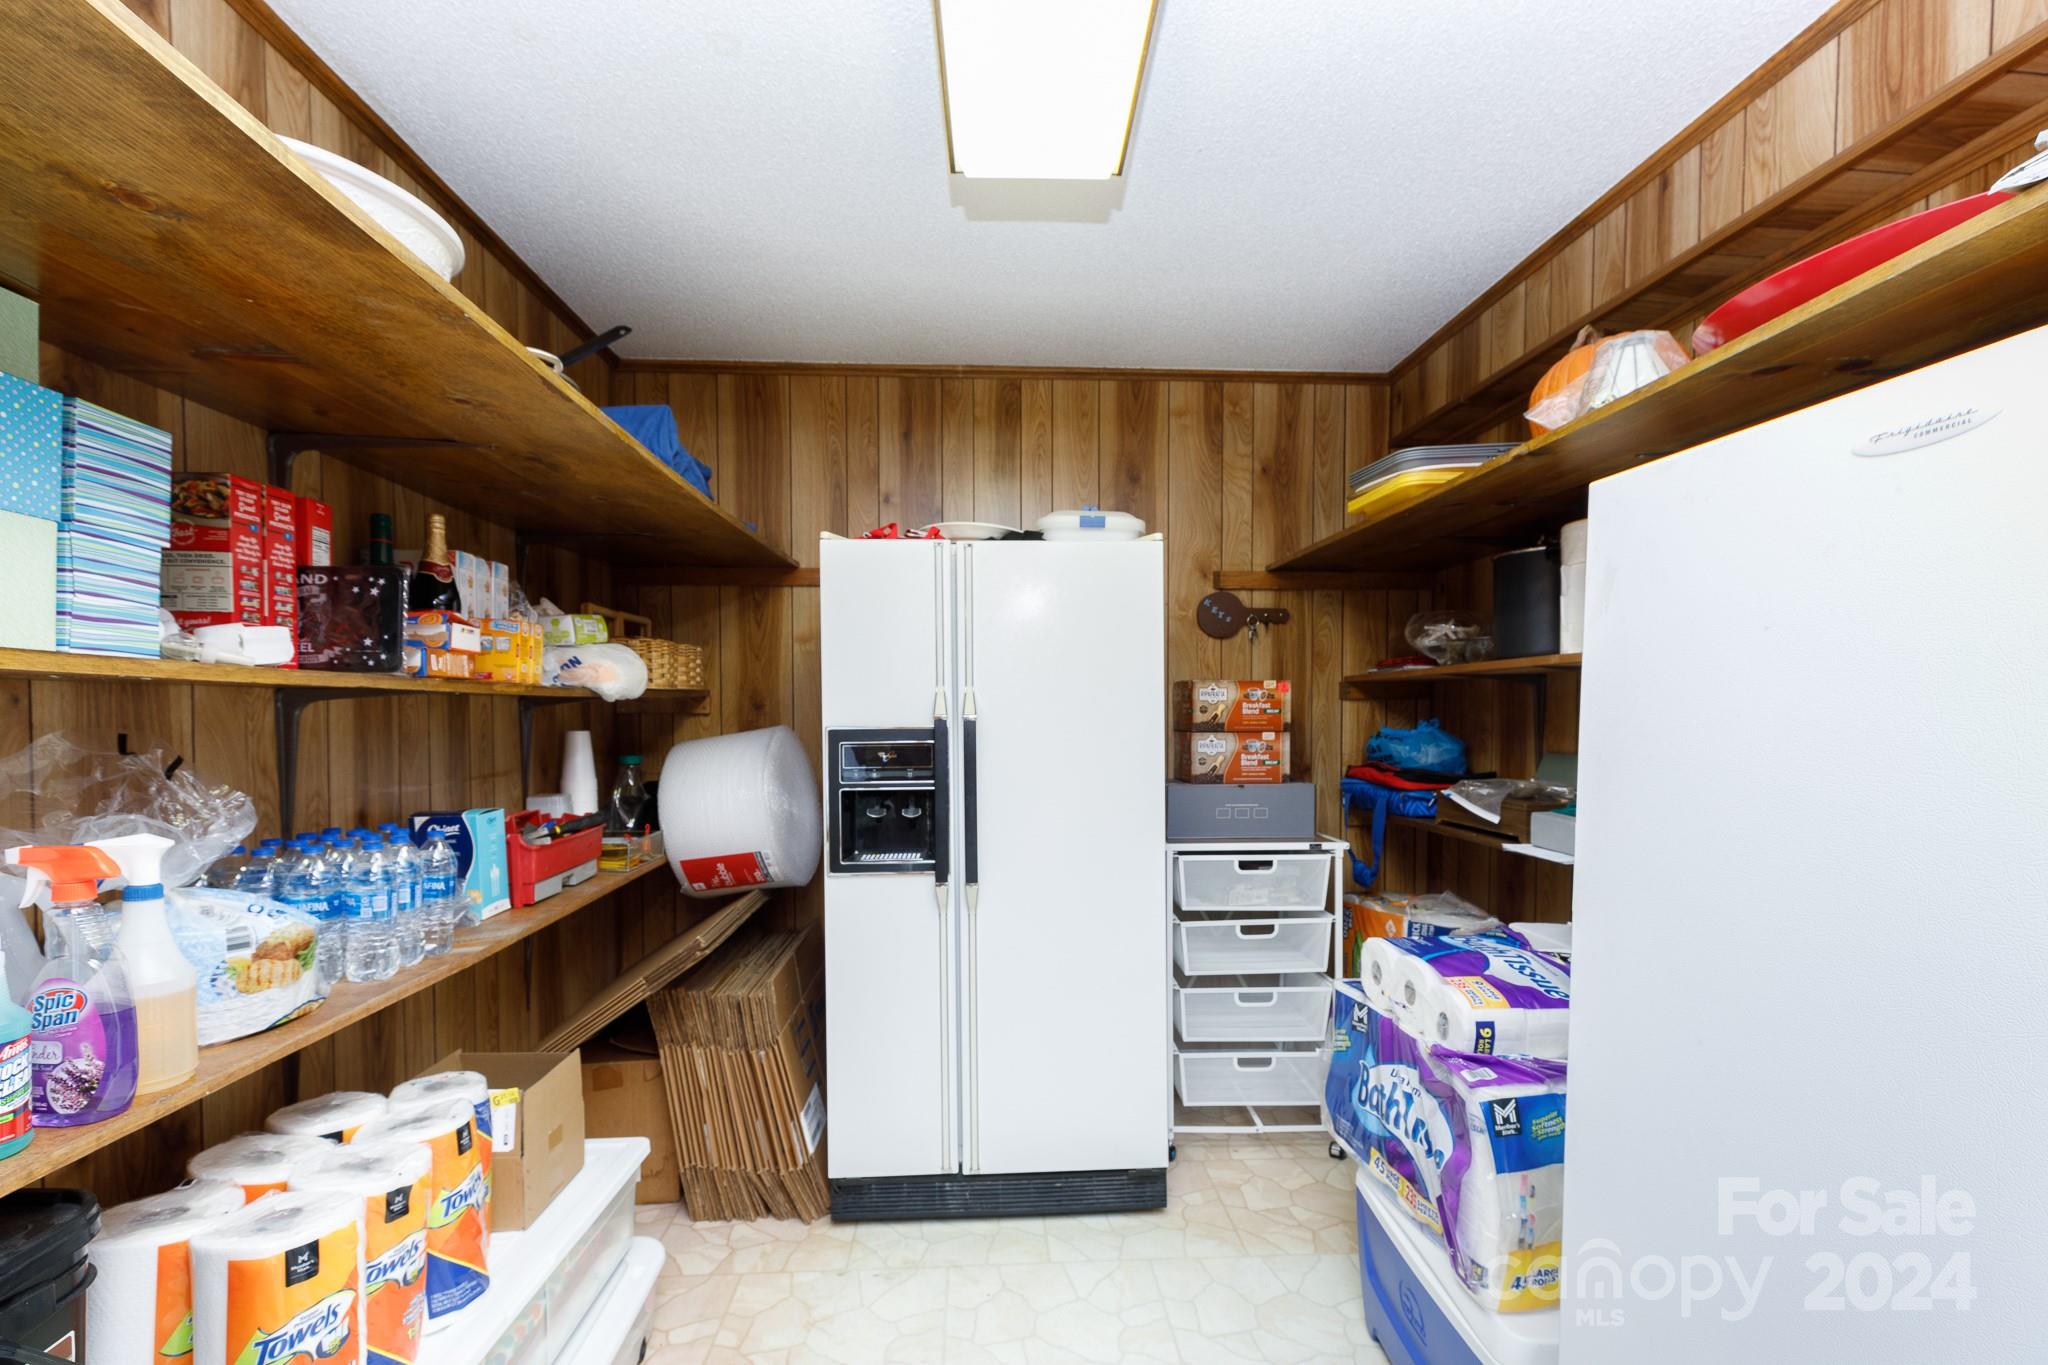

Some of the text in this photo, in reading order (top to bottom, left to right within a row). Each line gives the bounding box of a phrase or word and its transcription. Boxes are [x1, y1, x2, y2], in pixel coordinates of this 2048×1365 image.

[1913, 418, 1972, 439] COMMERCIAL
[297, 574, 328, 585] ND
[34, 993, 74, 1014] Spic
[32, 1010, 78, 1031] Span
[1374, 1156, 1385, 1174] 45
[253, 1302, 341, 1365] Towels
